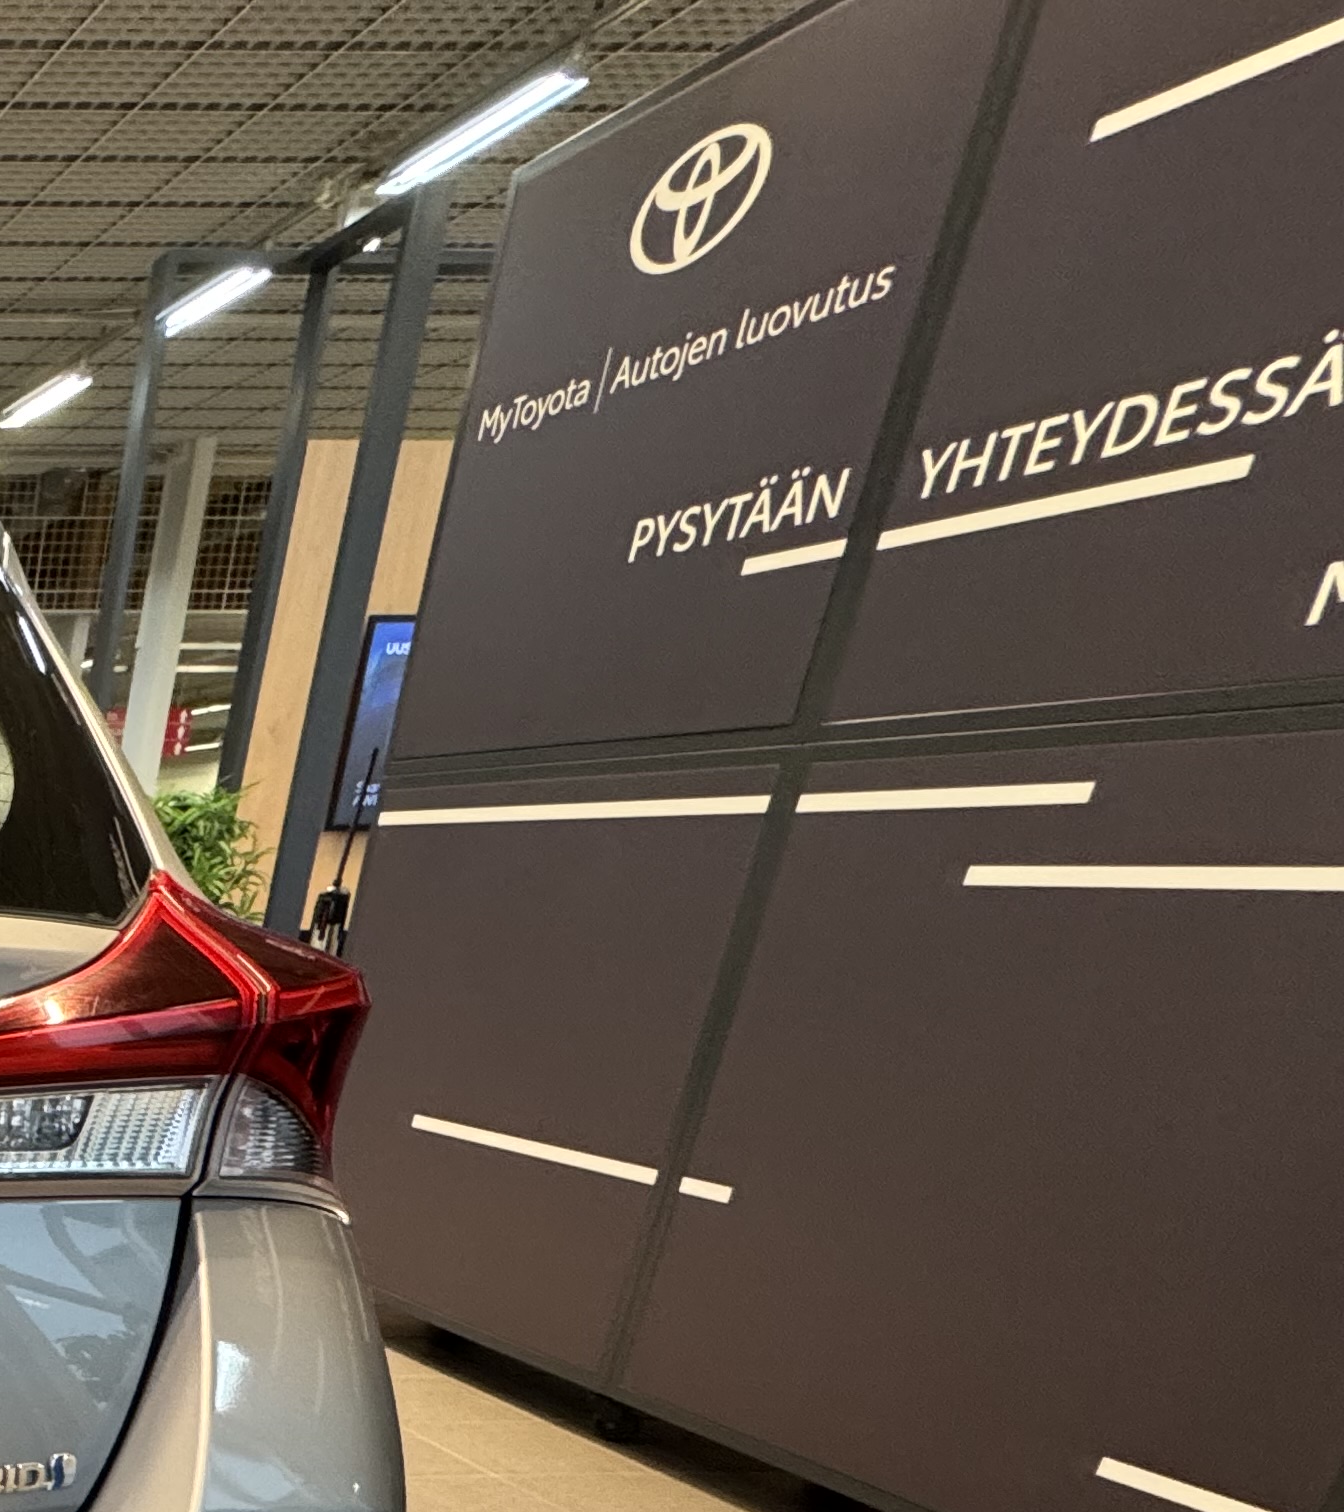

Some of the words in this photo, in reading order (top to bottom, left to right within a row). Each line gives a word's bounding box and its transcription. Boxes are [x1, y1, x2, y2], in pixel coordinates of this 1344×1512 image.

[477, 377, 592, 444] MyToyota
[609, 326, 728, 394] Autojen
[734, 264, 897, 350] luovutus
[627, 465, 853, 564] PYSYTÄÄN
[919, 328, 1344, 500] YHTEYDESSÄ
